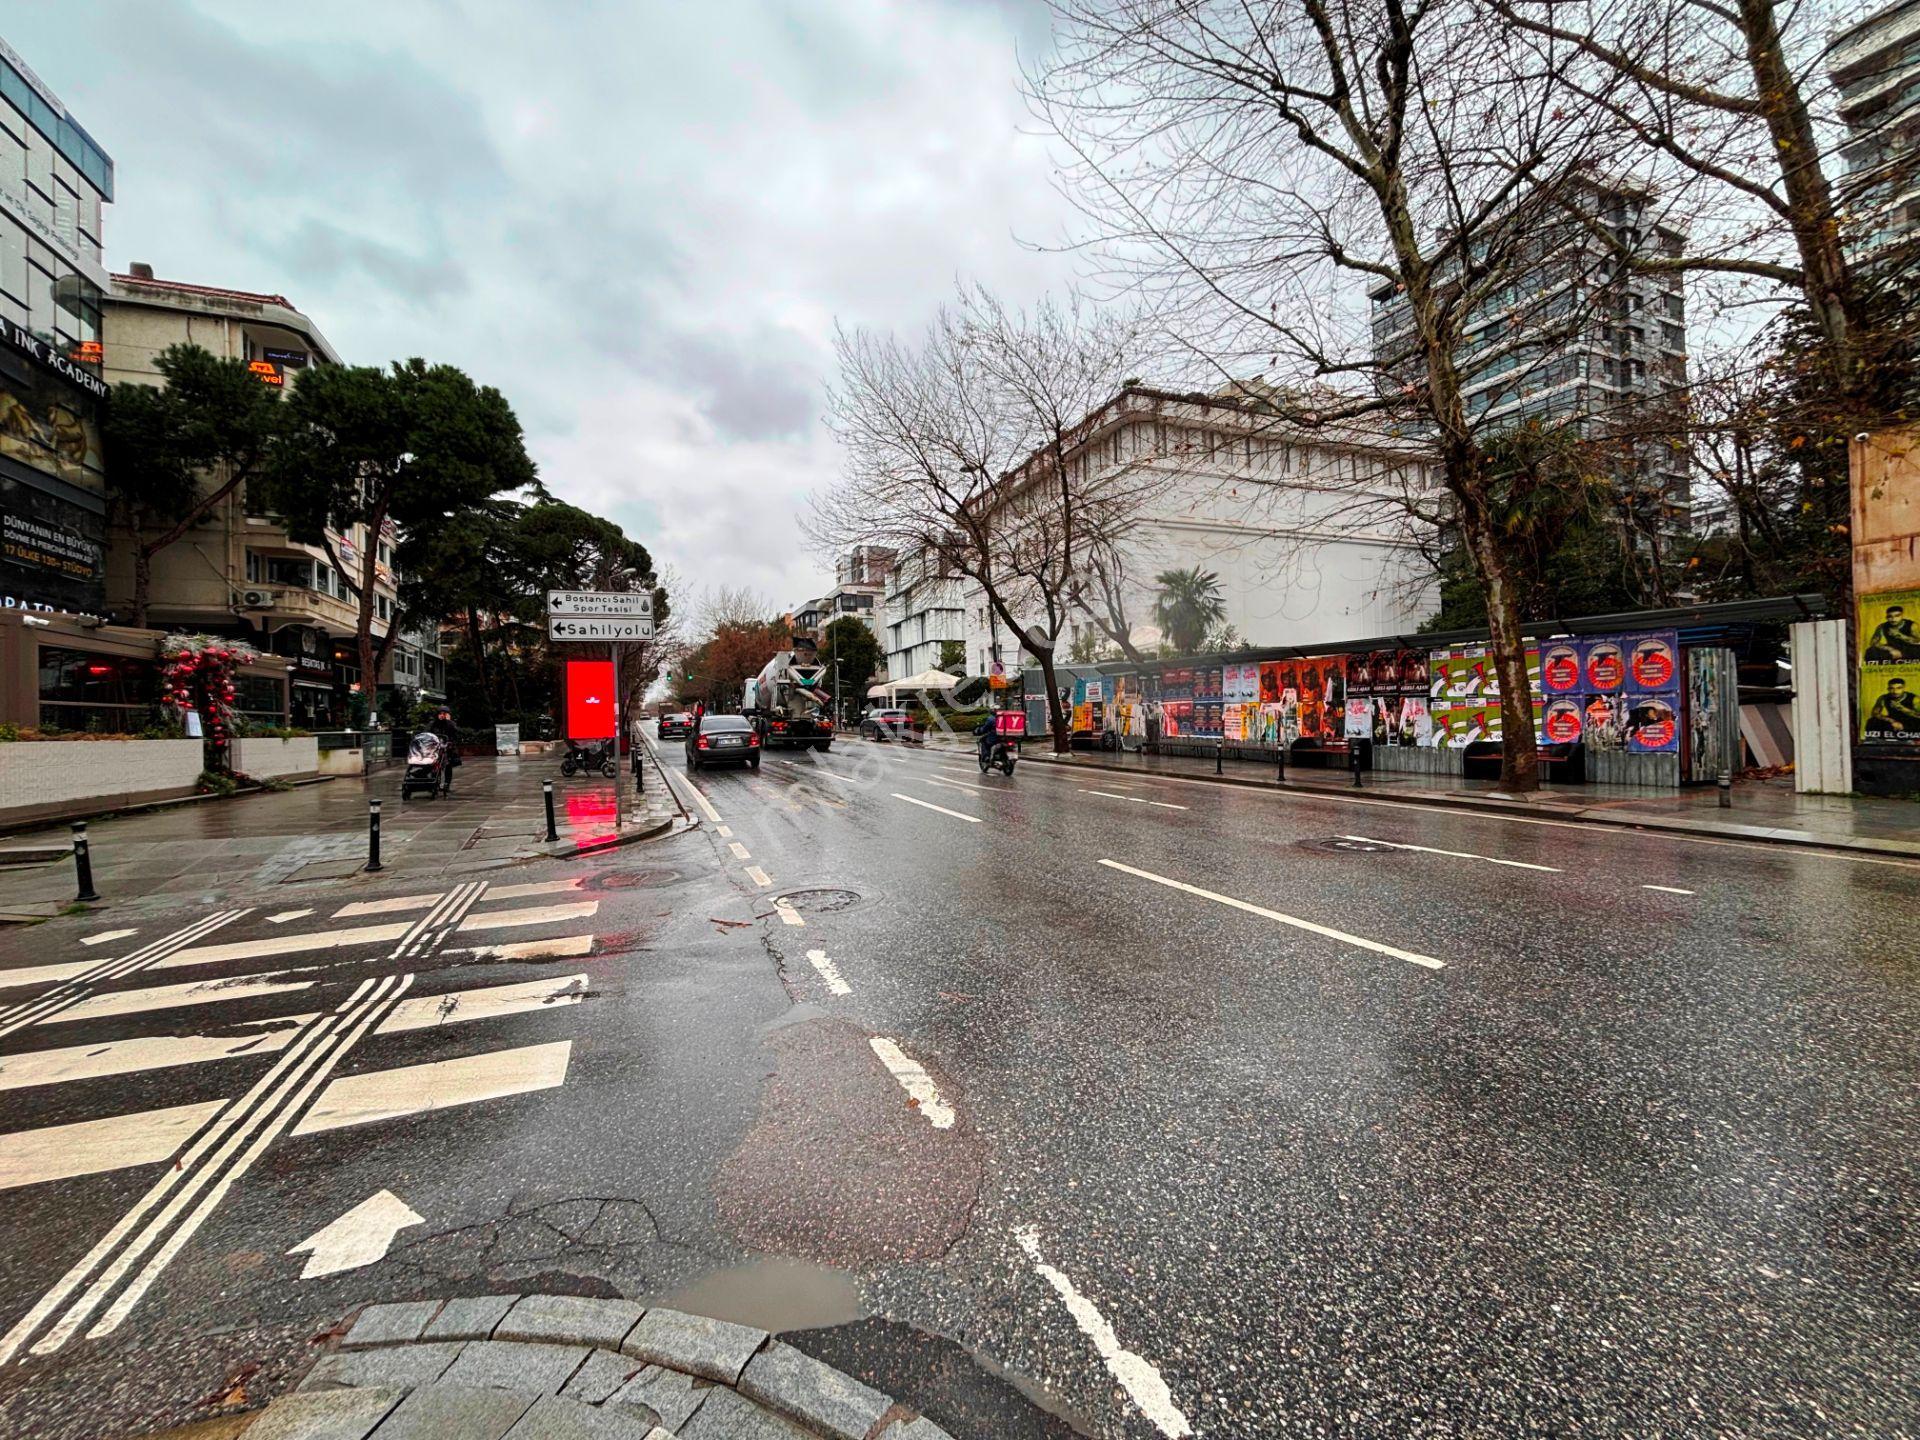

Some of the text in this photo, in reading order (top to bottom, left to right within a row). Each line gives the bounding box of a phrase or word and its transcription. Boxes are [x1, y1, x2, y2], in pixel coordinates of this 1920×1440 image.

[15, 328, 40, 359] INK
[4, 515, 52, 539] DÜNYANIN
[53, 532, 65, 544] EN
[17, 545, 40, 562] ÜLKE
[565, 594, 639, 604] Bostancı Sahil
[573, 604, 632, 613] Spor Tesisi
[567, 623, 650, 638] Sahilyolu
[1864, 730, 1881, 738] UZI
[1897, 731, 1920, 739] CHA
